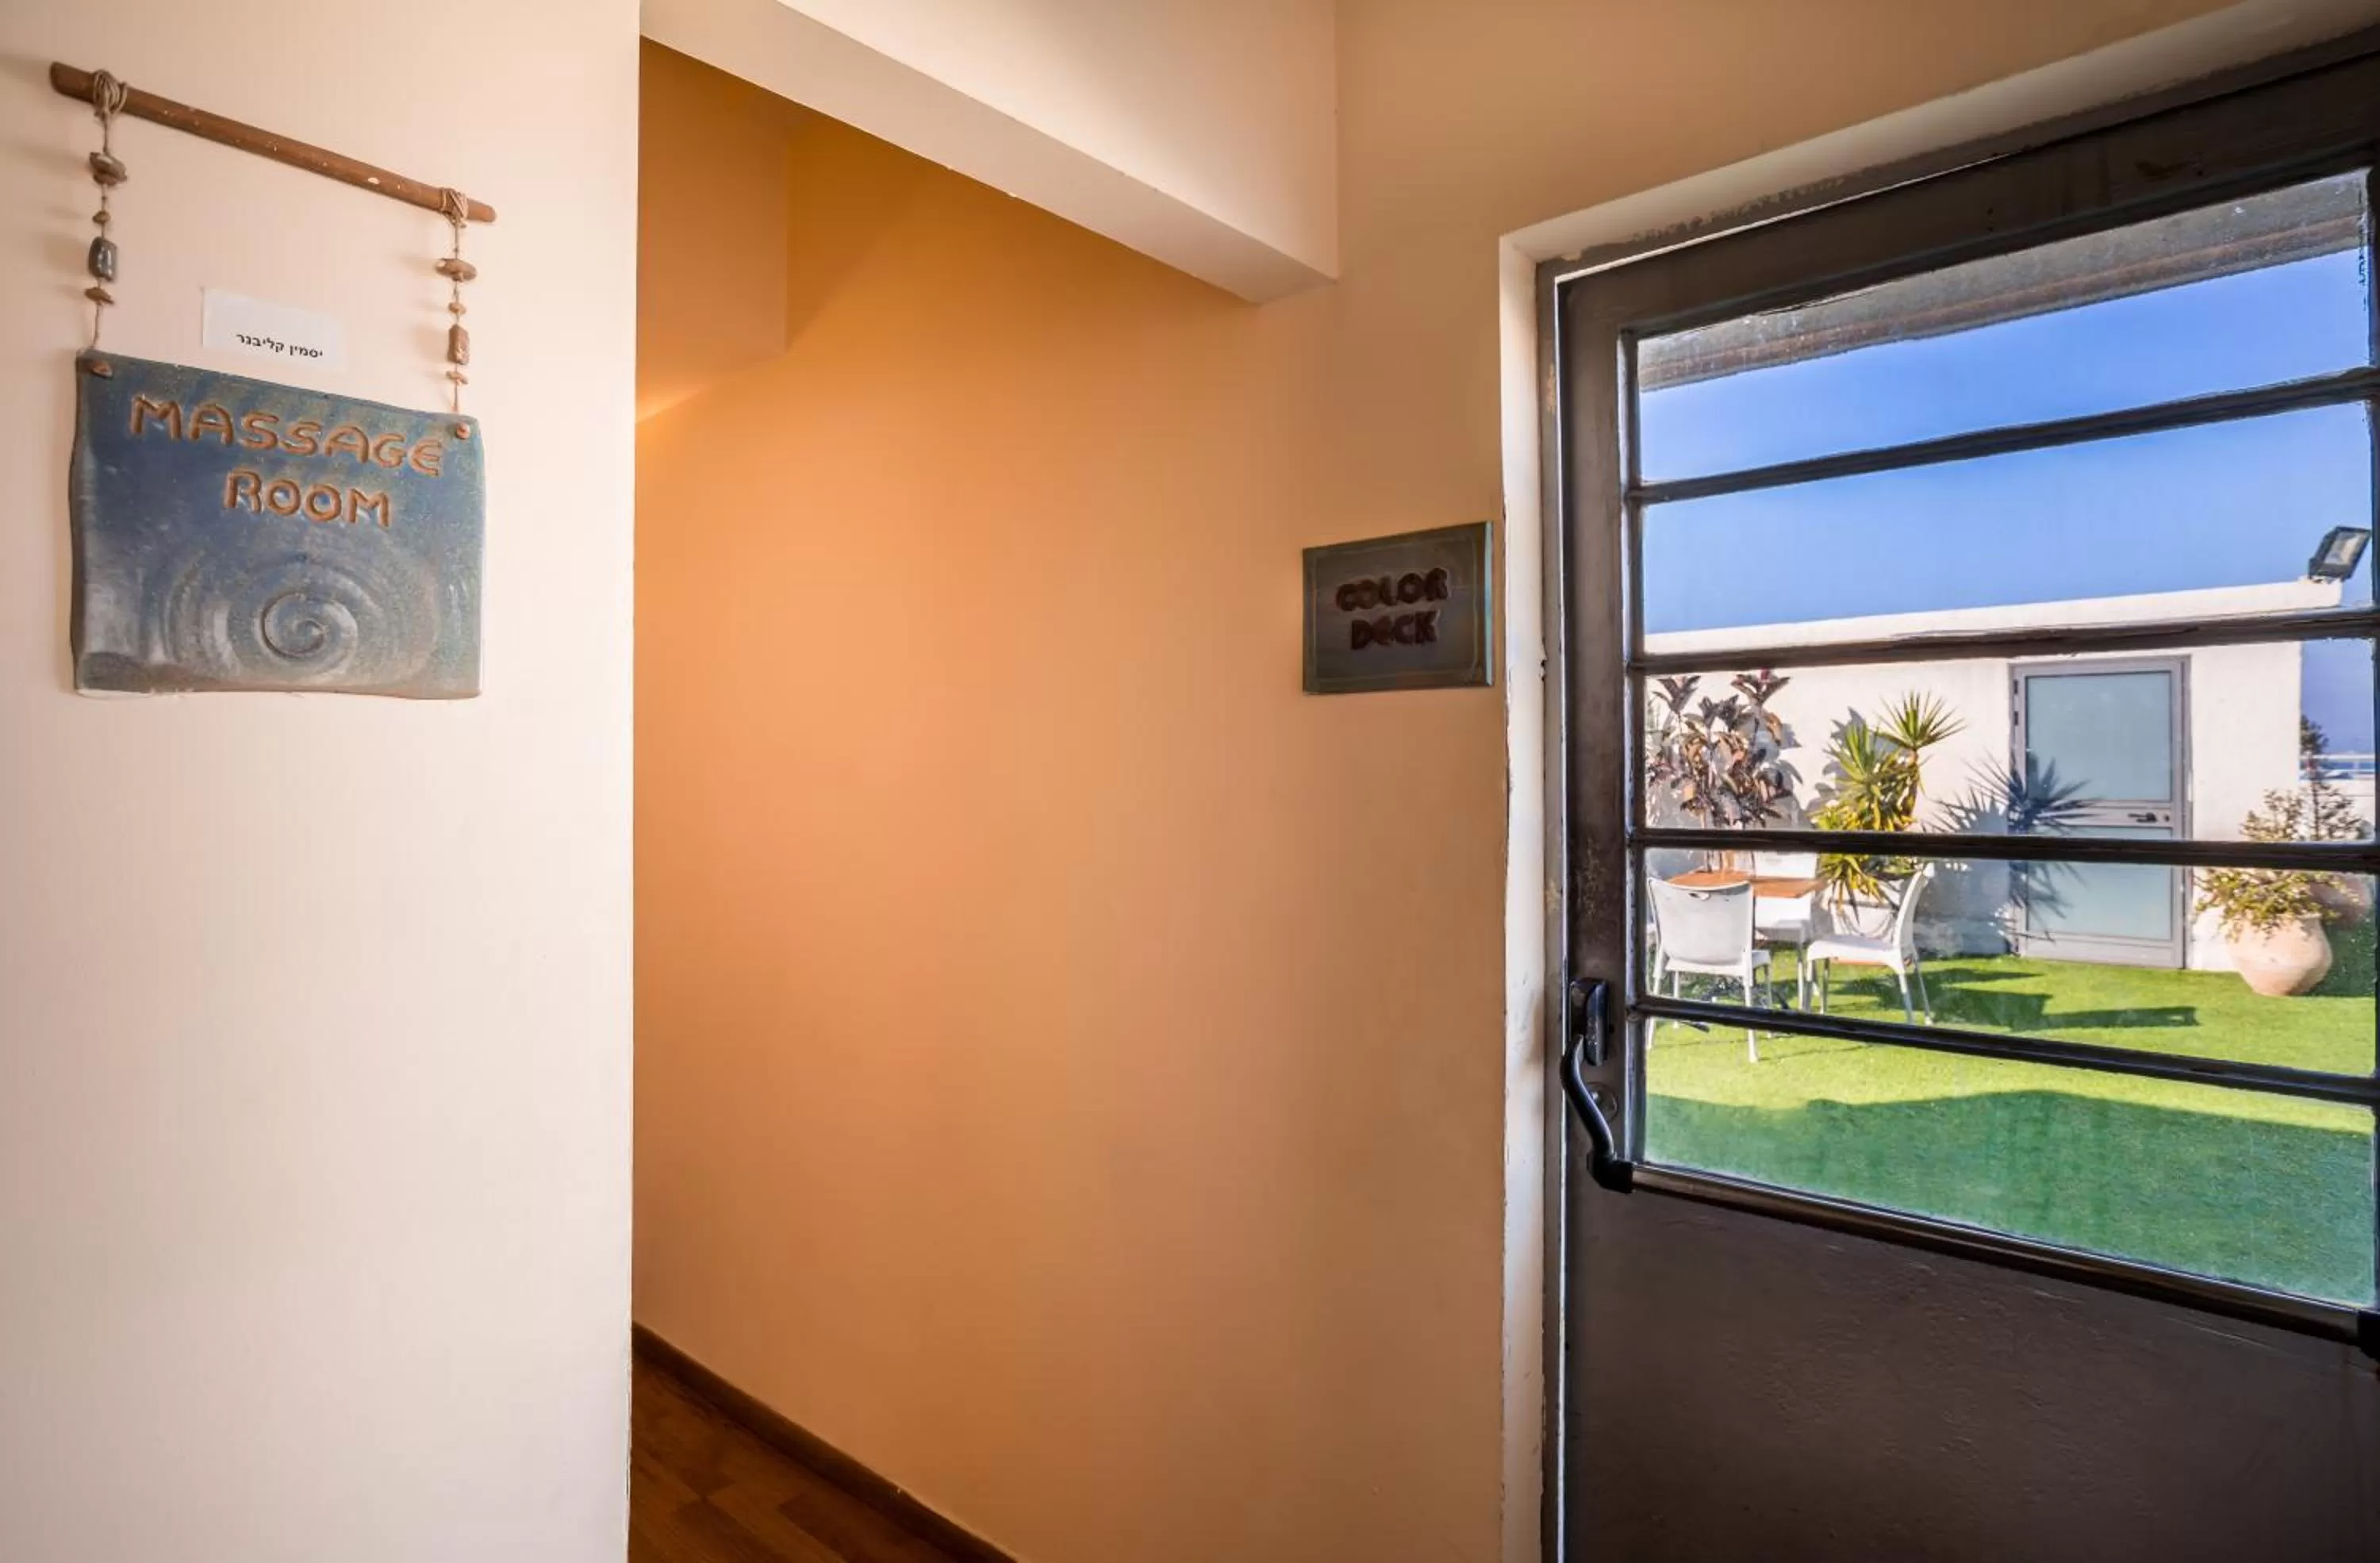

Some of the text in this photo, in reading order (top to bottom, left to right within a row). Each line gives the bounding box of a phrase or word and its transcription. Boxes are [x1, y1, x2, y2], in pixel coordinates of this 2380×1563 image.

[236, 334, 323, 357] יסמין קליבנר
[130, 395, 443, 475] MASSAGE
[223, 468, 391, 527] ROOM
[1336, 566, 1449, 612] COLOR
